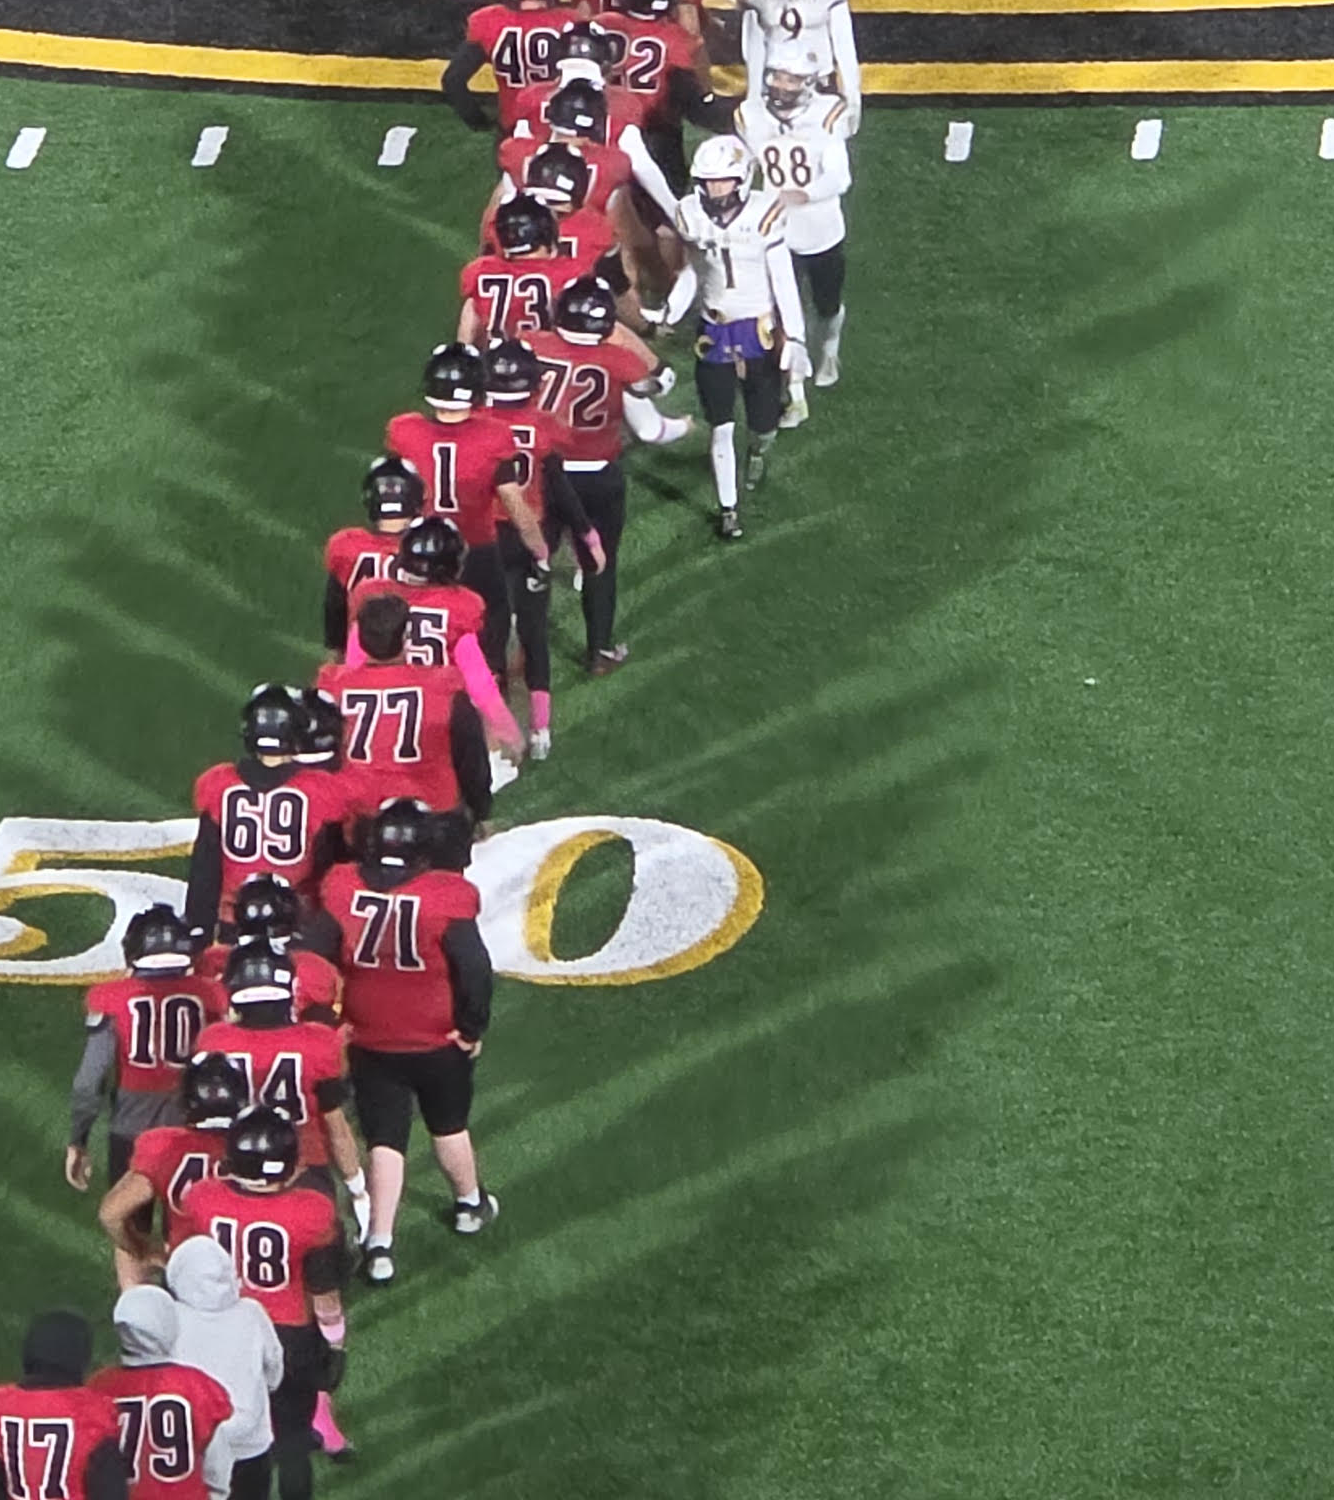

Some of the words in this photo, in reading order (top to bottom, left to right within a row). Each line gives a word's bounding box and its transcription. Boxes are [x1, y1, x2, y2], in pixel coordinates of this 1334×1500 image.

[492, 27, 561, 87] 49
[780, 7, 802, 41] 9
[764, 145, 811, 188] 88
[478, 274, 551, 340] 73
[536, 357, 609, 430] 72
[432, 443, 458, 512] 1
[341, 686, 423, 764] 77
[221, 785, 309, 866] 69
[351, 890, 425, 971] 71
[128, 994, 204, 1067] 10
[211, 1216, 288, 1293] 18
[1, 1417, 75, 1500] 17
[115, 1394, 194, 1484] 79
